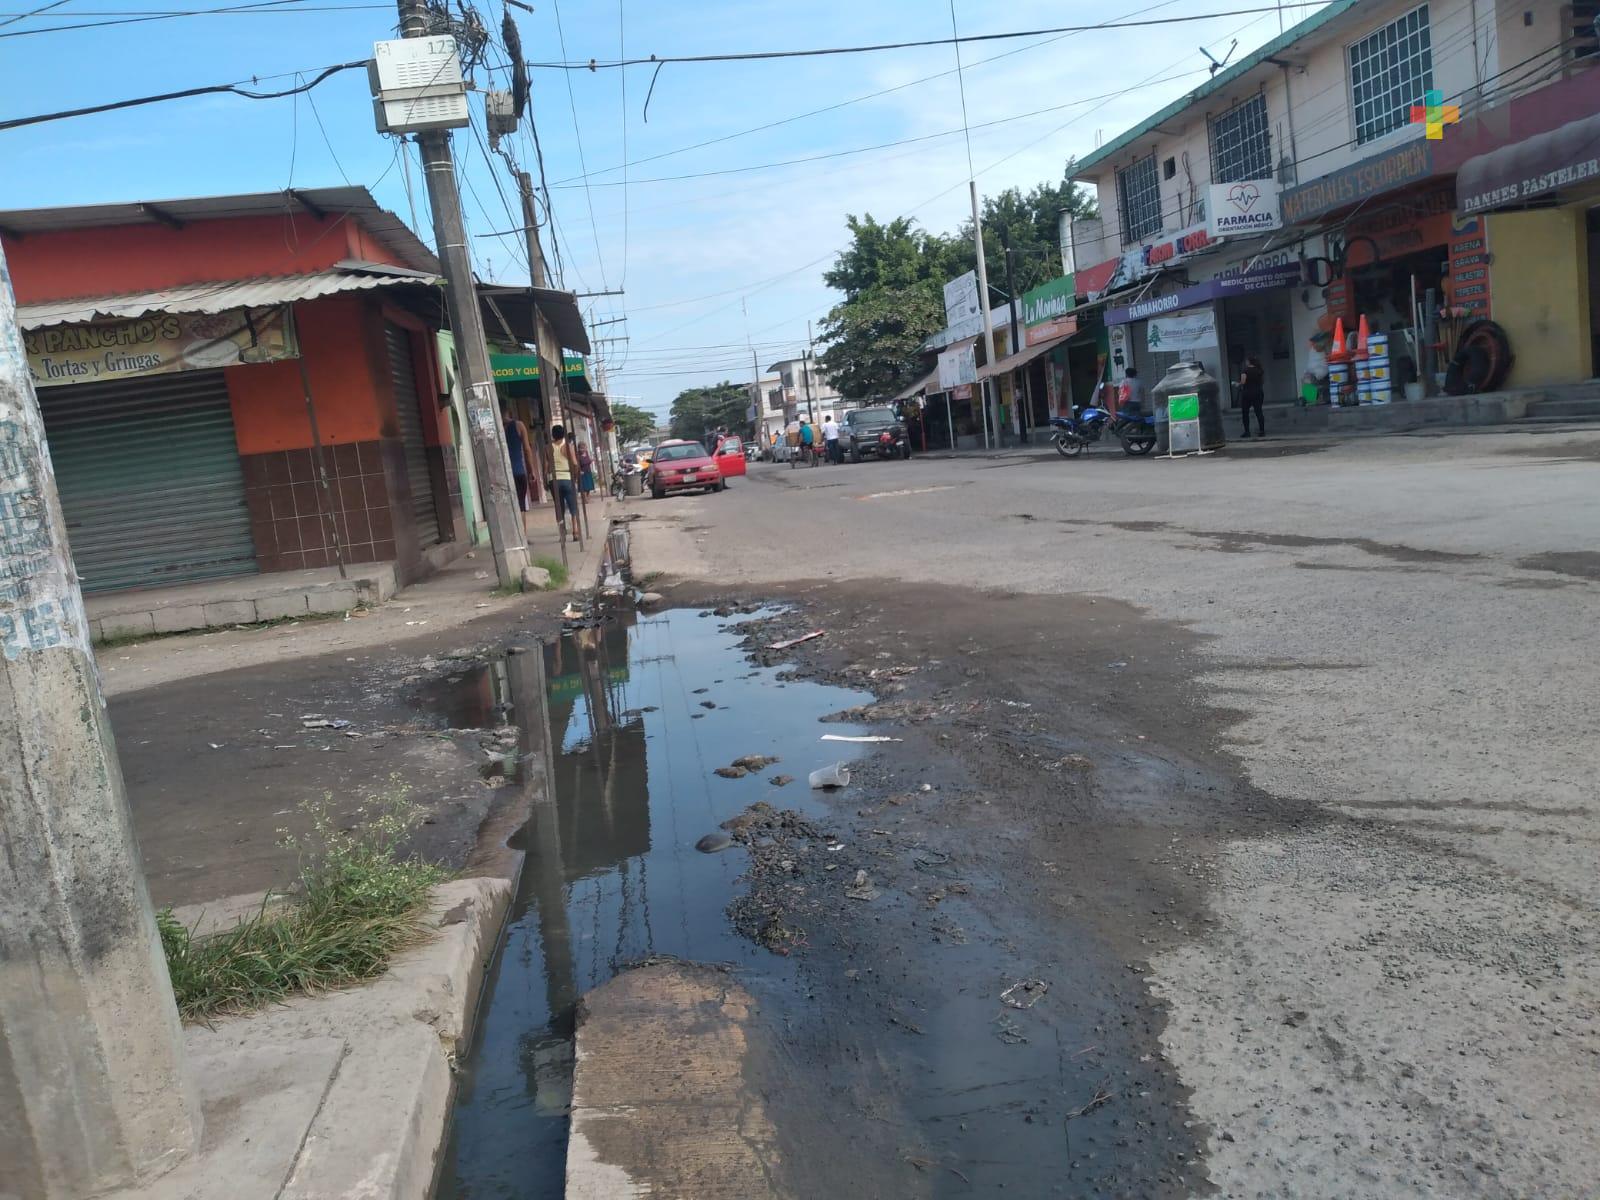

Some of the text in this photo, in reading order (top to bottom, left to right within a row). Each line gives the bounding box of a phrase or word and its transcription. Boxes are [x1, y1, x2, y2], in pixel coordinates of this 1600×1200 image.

[1464, 158, 1600, 213] DANNES PASTELER
[1282, 176, 1355, 221] MATERIALES
[1217, 212, 1273, 226] FARMACIA
[1454, 240, 1481, 253] ARENA
[1220, 274, 1273, 287] MEDICAMENTO
[1128, 295, 1179, 319] FARMAHORRO
[45, 316, 182, 355] PANCHO'S
[42, 357, 88, 379] Tortas
[92, 362, 100, 377] y
[104, 350, 161, 373] Gringas
[488, 368, 514, 377] ACOS
[515, 368, 521, 376] Y
